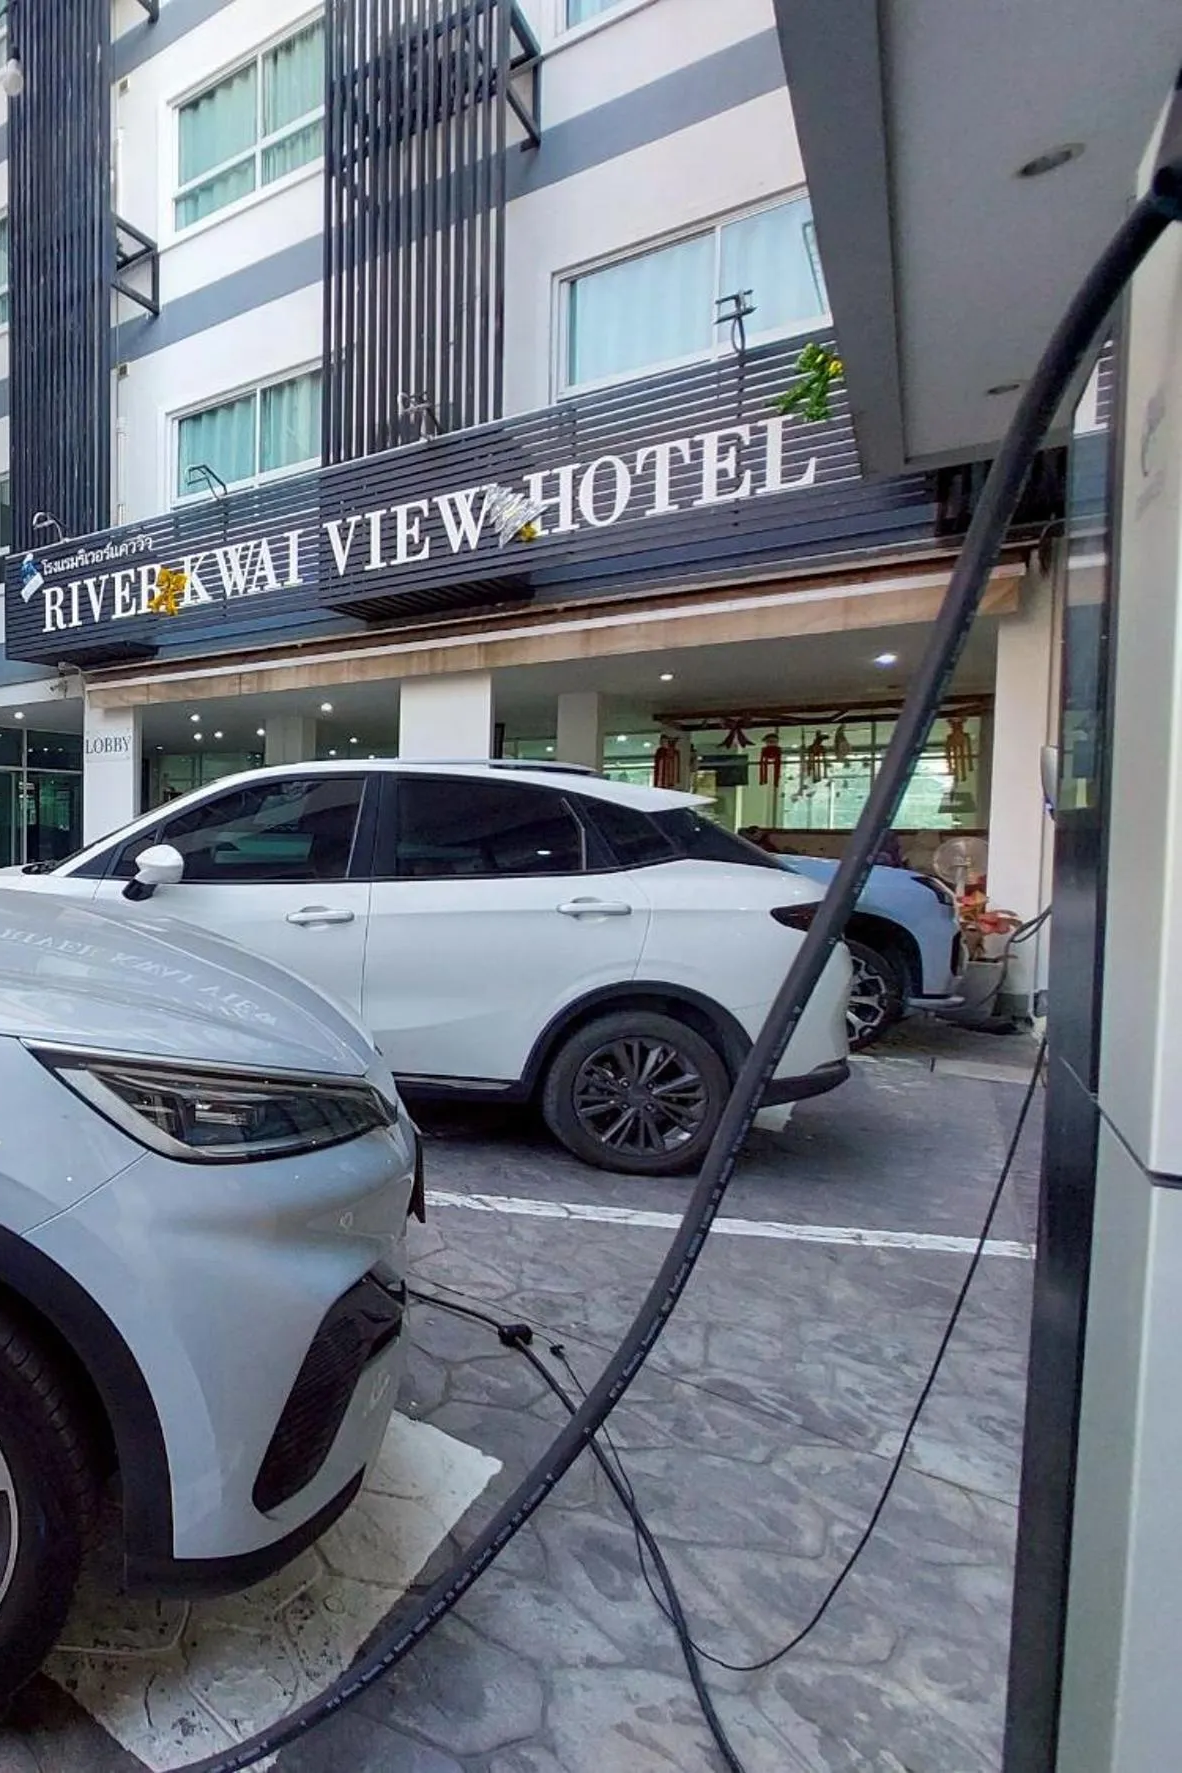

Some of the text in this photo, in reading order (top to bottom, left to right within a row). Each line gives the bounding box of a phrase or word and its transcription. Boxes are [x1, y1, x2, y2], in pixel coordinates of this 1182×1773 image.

[179, 529, 304, 607] KWAI
[322, 482, 499, 577] VIEW
[522, 414, 817, 538] HOTEL
[85, 735, 131, 754] LOBBY
